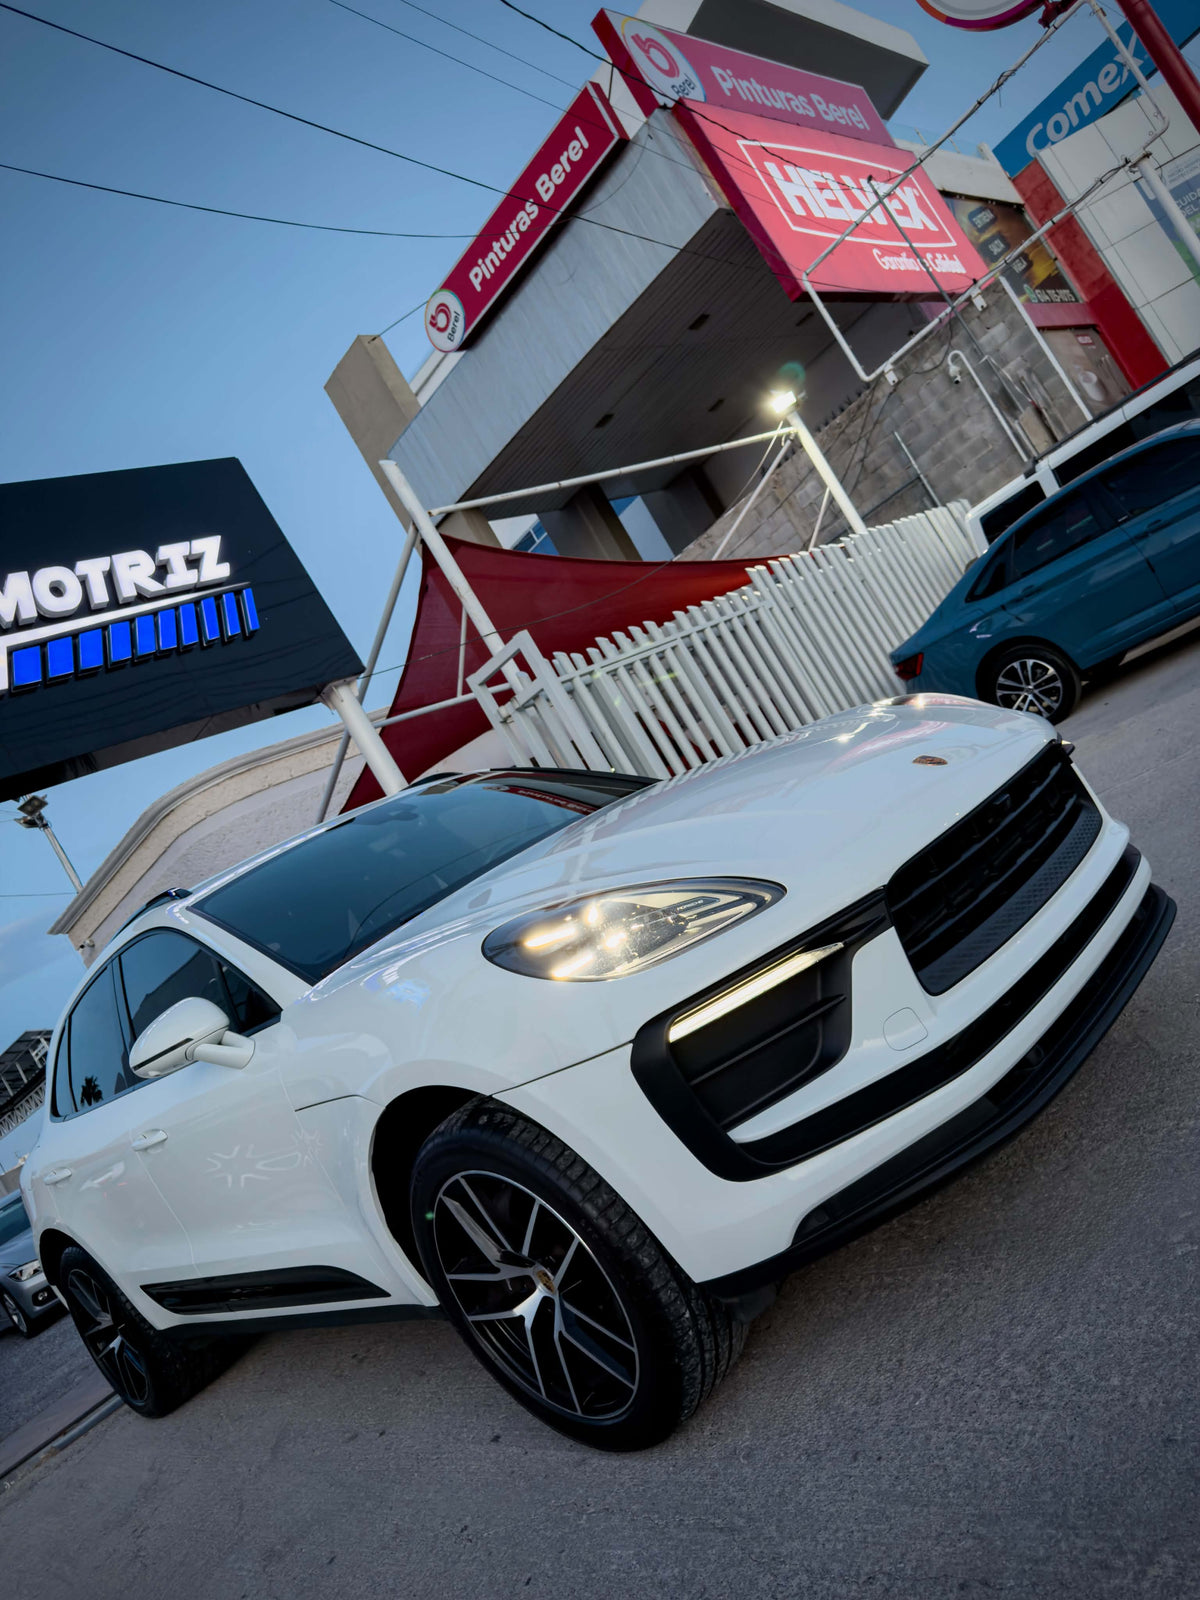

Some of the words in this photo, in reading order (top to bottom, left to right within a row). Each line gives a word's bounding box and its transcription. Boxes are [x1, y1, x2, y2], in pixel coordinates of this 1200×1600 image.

[710, 65, 816, 118] Pinturas
[809, 92, 871, 131] Berel
[468, 198, 540, 293] Pinturas
[534, 125, 590, 203] Berel
[763, 161, 940, 232] HELVEX
[447, 310, 461, 342] Berel
[0, 535, 231, 629] MOTRIZ
